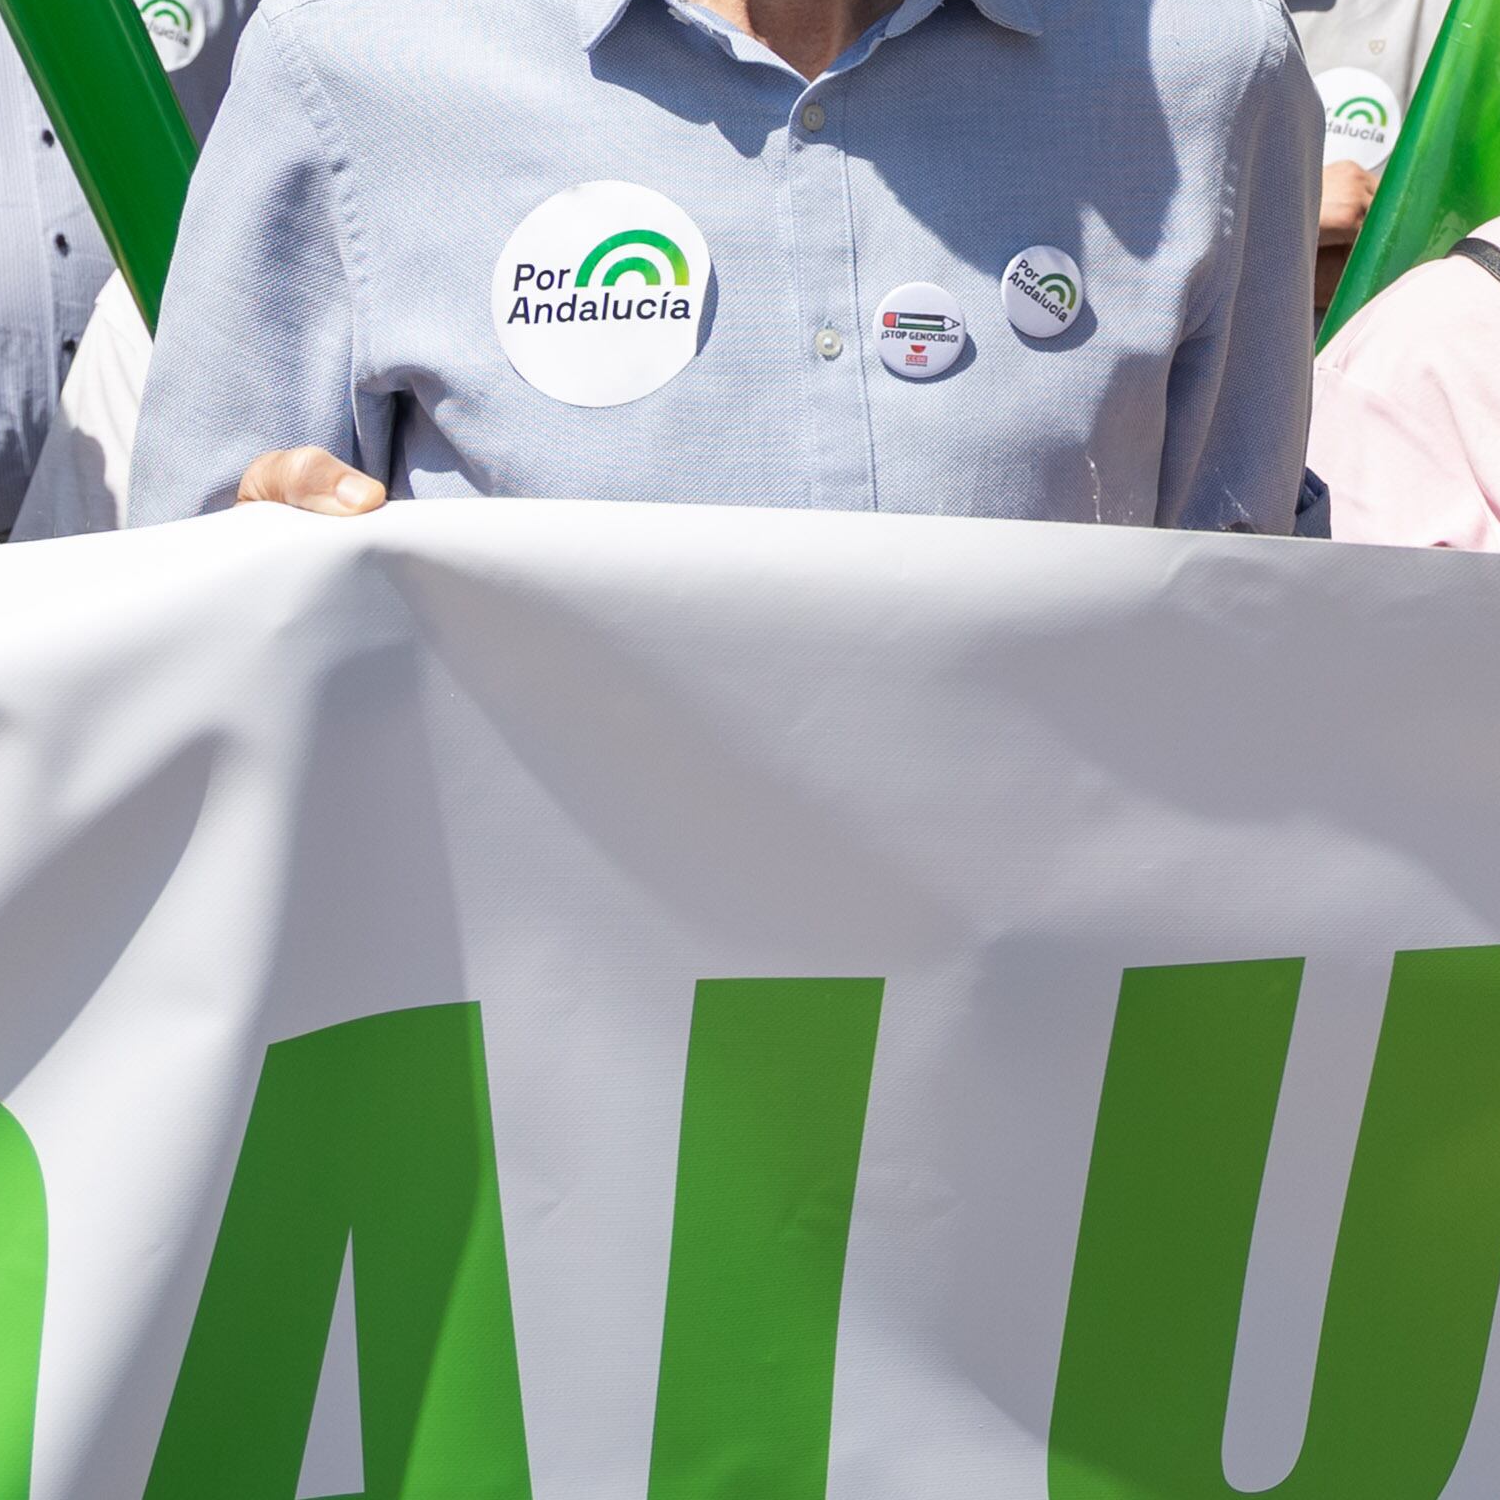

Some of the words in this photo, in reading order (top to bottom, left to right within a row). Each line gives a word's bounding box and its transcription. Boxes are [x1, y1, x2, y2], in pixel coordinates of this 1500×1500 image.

[513, 263, 571, 292] Por
[1016, 258, 1040, 281] Por
[506, 291, 691, 325] Andalucía
[1007, 271, 1068, 323] Andalucía
